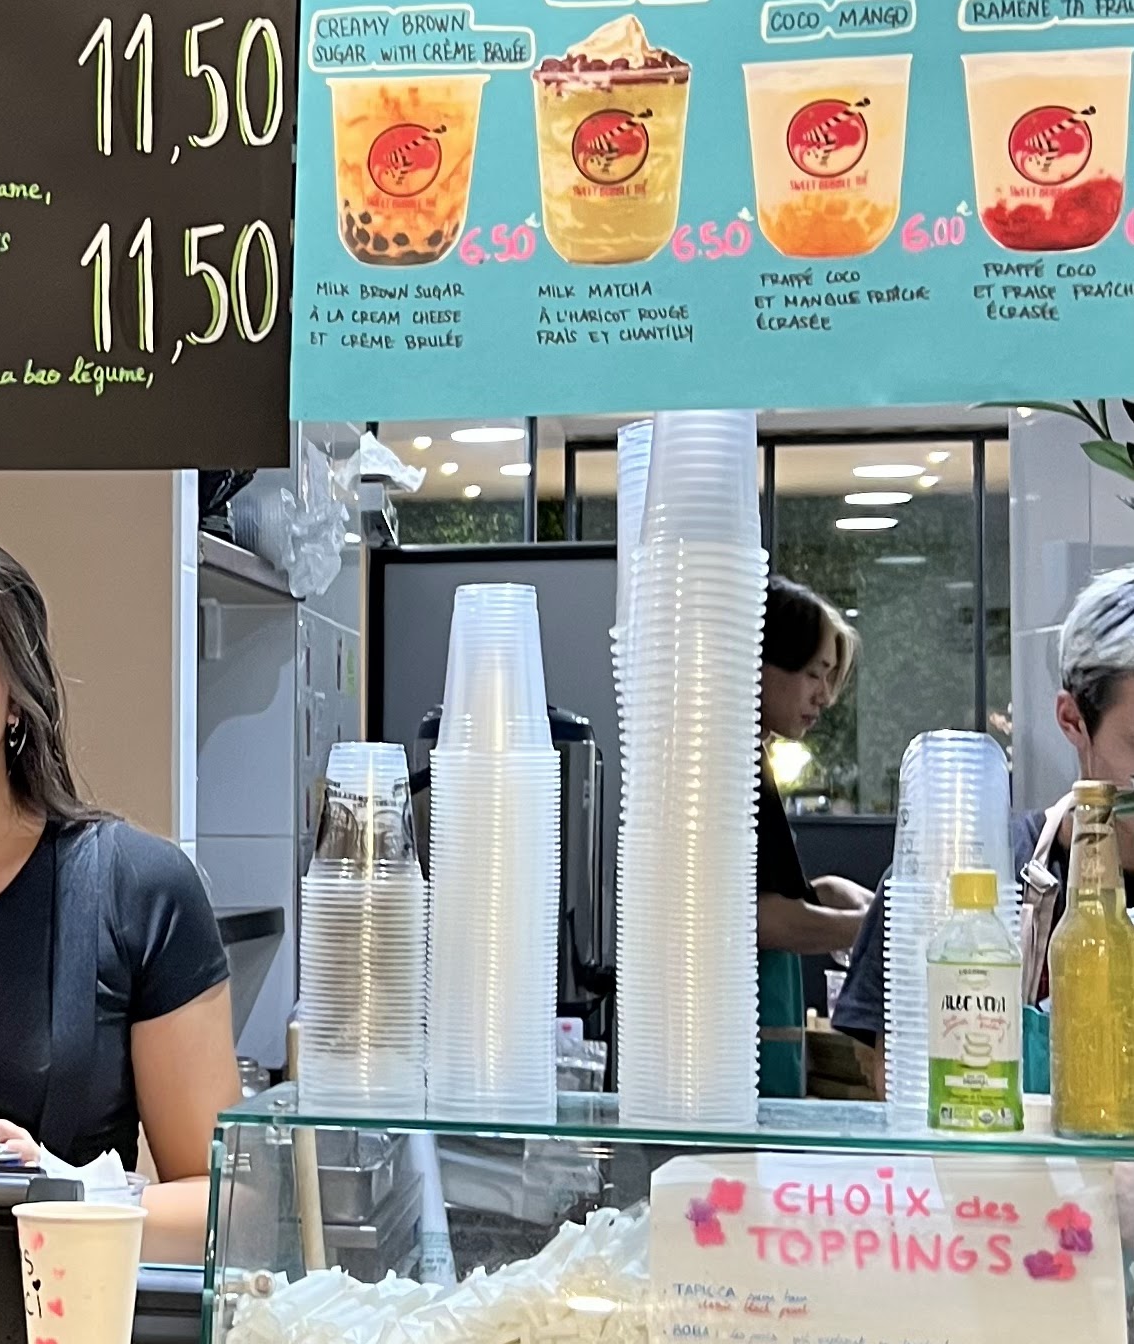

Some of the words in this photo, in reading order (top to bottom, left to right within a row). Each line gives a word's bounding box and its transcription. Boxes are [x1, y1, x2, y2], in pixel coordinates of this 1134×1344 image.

[316, 15, 390, 40] CREAMY
[402, 11, 466, 36] BROWN
[770, 12, 820, 33] COCO
[838, 6, 909, 29] MANGO
[315, 44, 366, 65] SUGAR
[78, 13, 285, 164] 11,50
[902, 213, 966, 253] 6.00
[826, 270, 861, 284] COCO
[1056, 264, 1097, 278] COCO
[78, 217, 282, 364] 11,50
[360, 284, 409, 300] BROWN
[588, 281, 653, 298] MATCHA
[327, 309, 344, 323] LA
[352, 310, 400, 325] CREAM
[412, 310, 461, 325] CHEESE
[638, 305, 689, 322] ROUGE
[955, 1196, 1020, 1223] des
